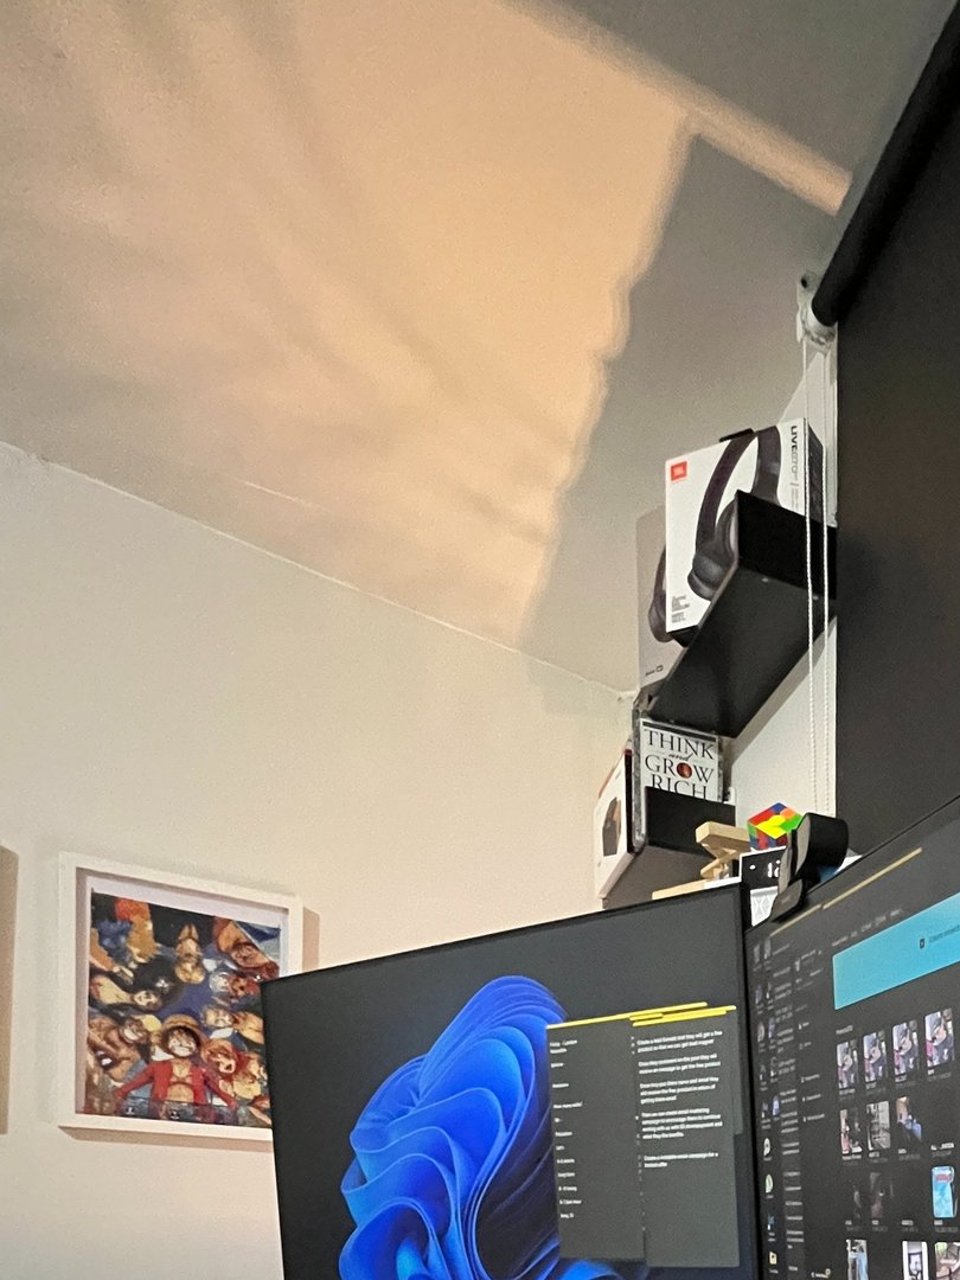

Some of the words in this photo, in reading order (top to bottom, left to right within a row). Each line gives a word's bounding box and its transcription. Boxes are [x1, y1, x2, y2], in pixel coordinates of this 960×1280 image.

[644, 728, 715, 760] THINK
[645, 755, 714, 783] GROW
[652, 774, 707, 799] RICH
